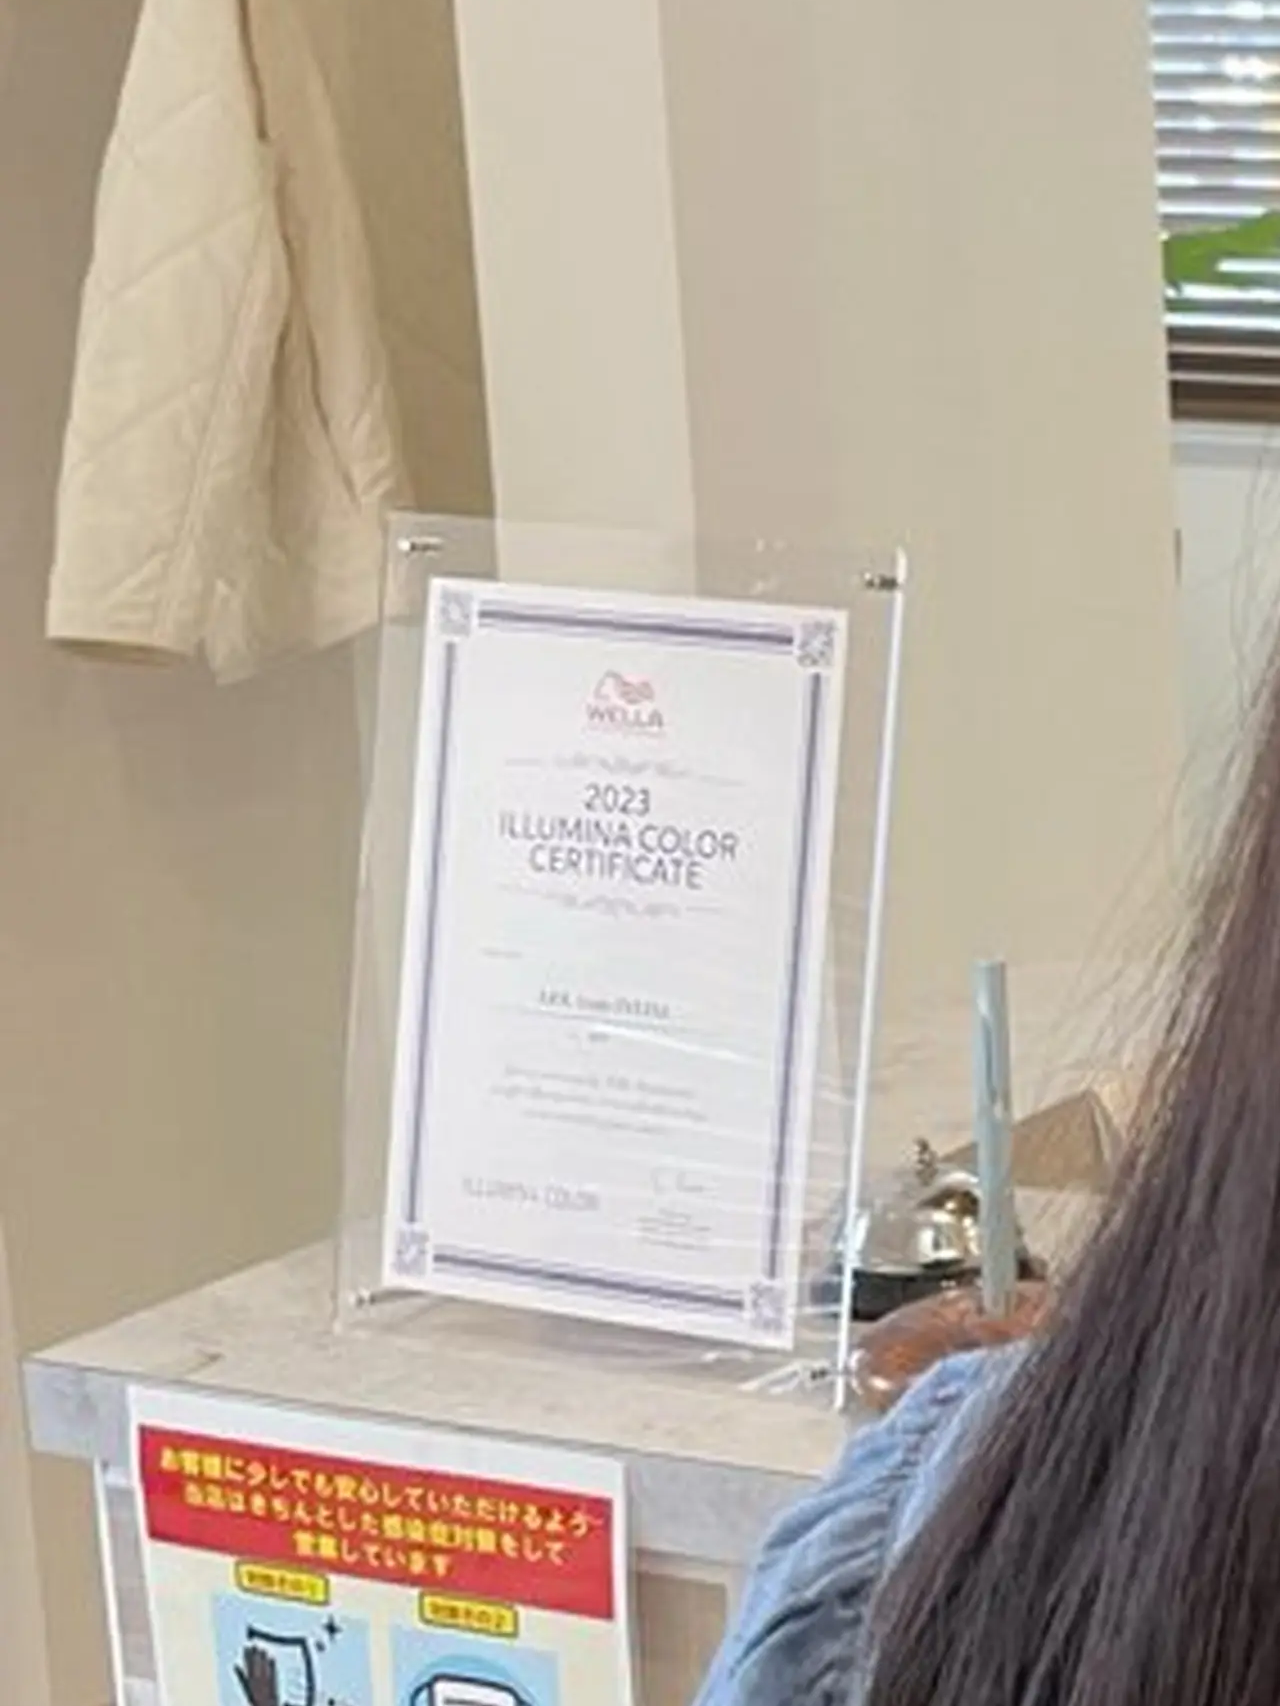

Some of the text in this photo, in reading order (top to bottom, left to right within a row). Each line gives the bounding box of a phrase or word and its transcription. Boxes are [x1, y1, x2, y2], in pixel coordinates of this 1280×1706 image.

[586, 703, 664, 729] WELLA
[584, 782, 650, 817] 2023
[499, 810, 740, 862] ILLUMINA COLOR
[528, 843, 703, 891] CERTIFICATE
